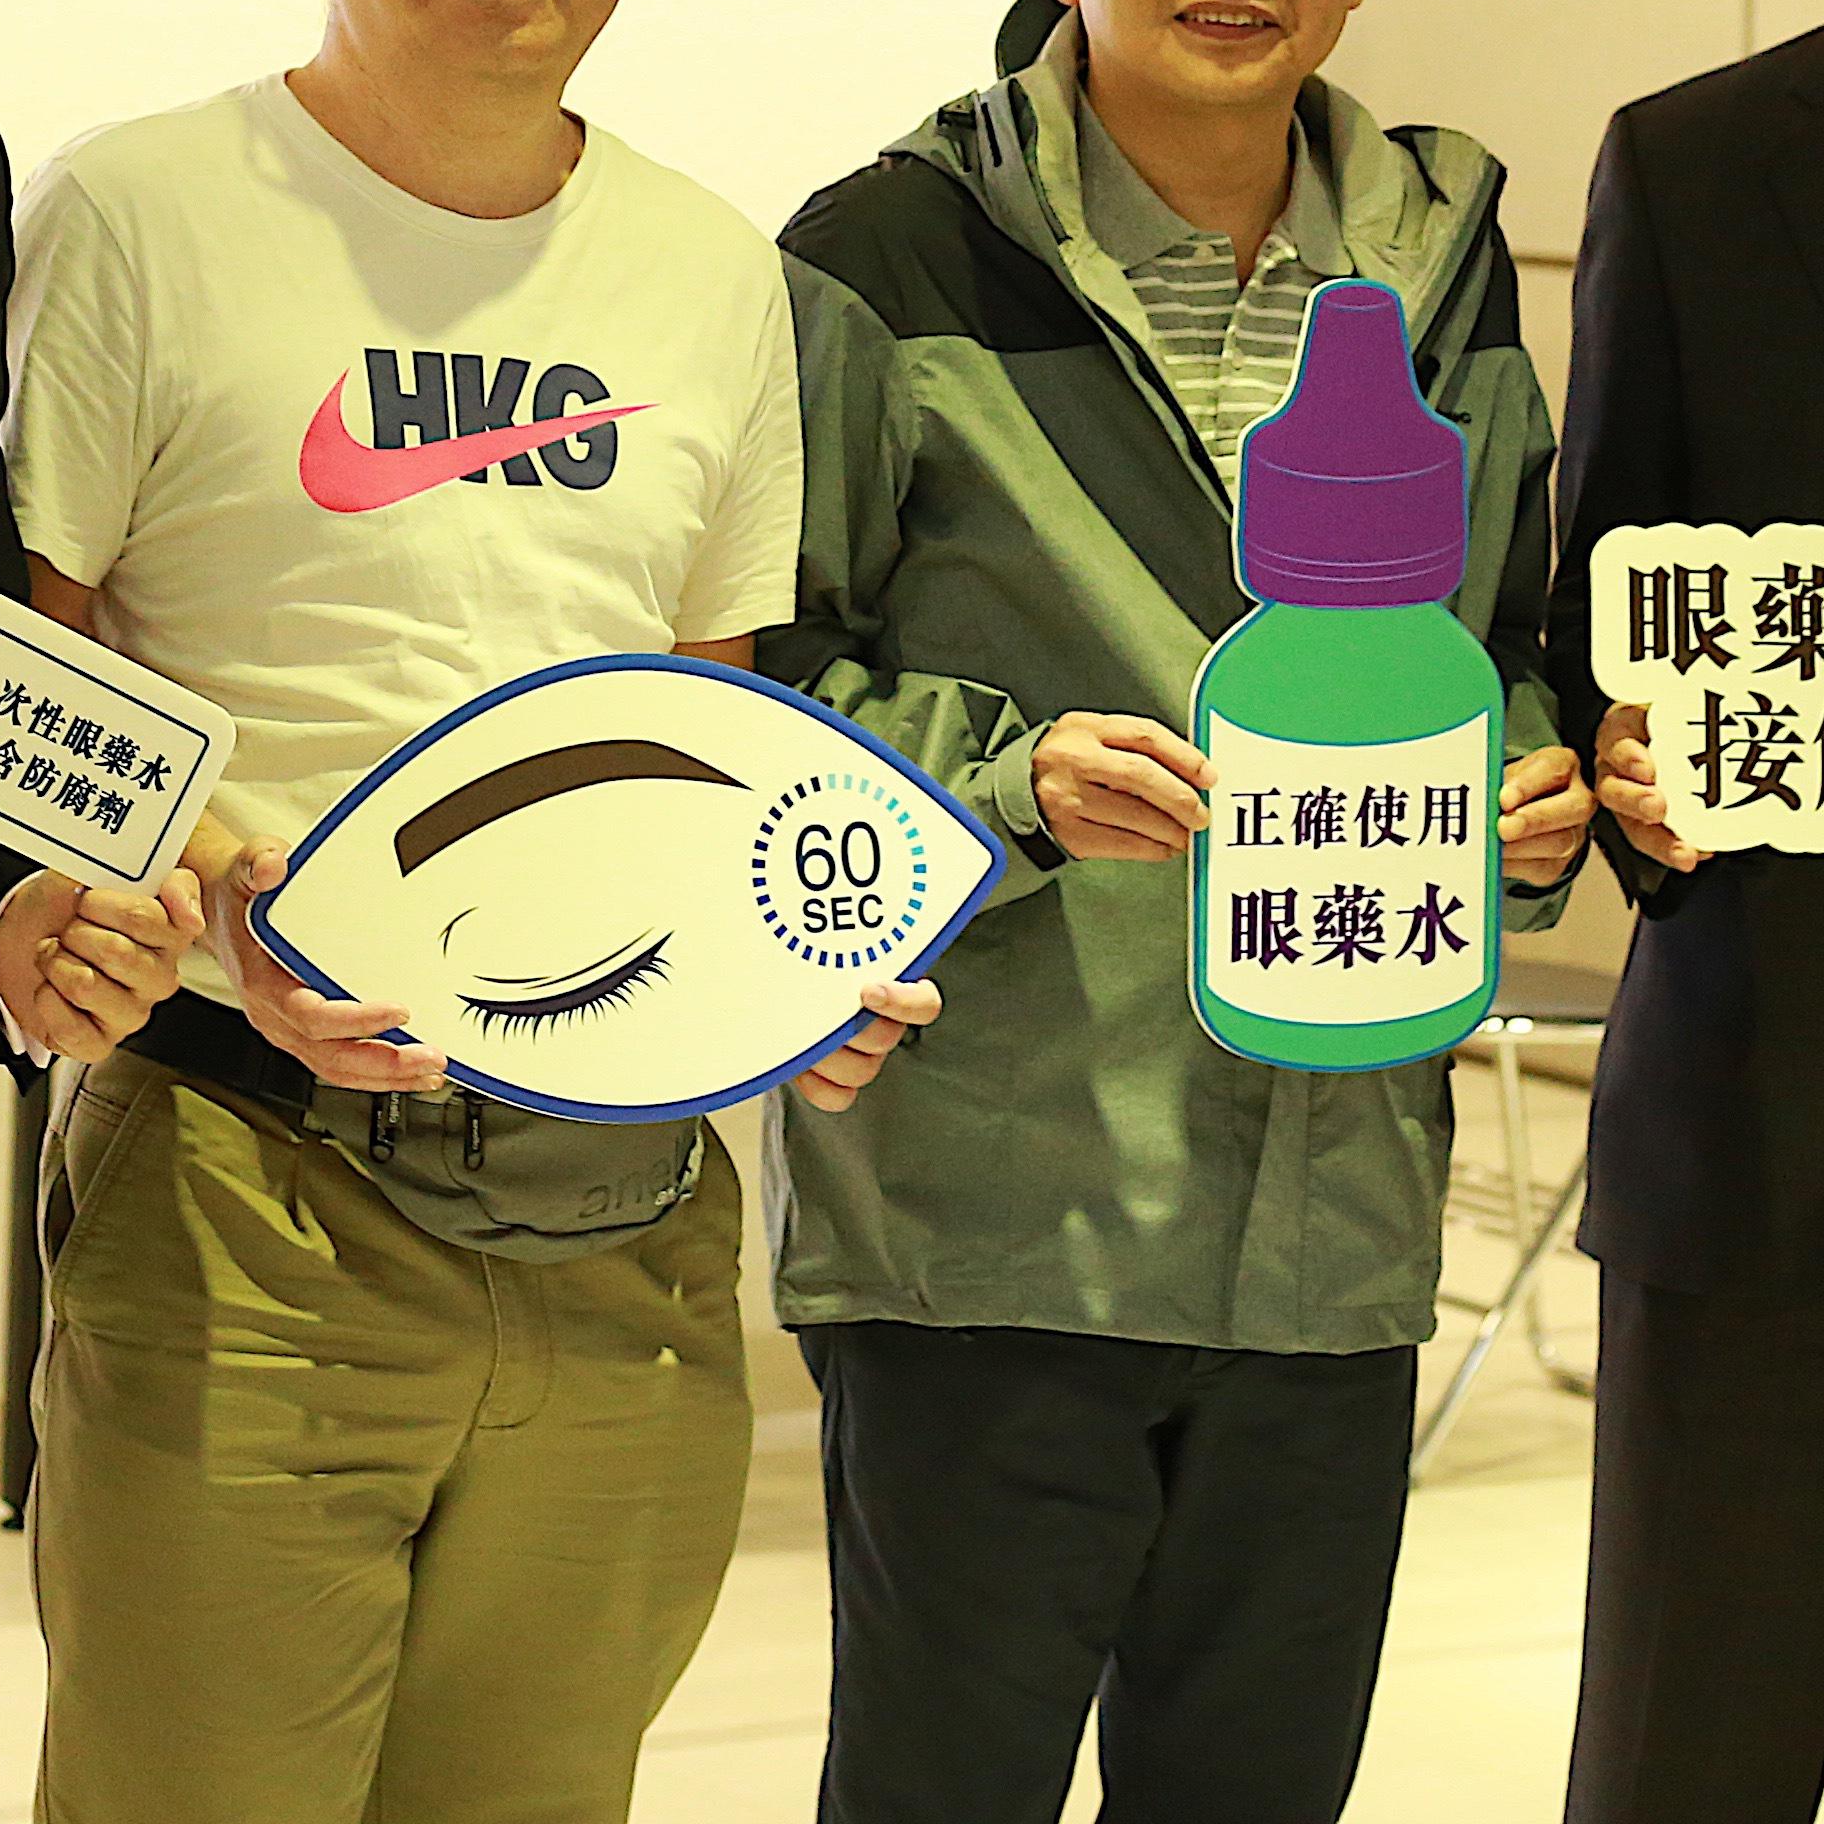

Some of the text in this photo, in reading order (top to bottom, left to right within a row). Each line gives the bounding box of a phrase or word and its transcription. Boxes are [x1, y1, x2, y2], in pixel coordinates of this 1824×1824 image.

[364, 348, 618, 490] HKG
[1227, 784, 1470, 849] 正確使用
[795, 821, 881, 891] 60
[802, 893, 884, 933] SEC
[1230, 883, 1469, 969] 眼藥水
